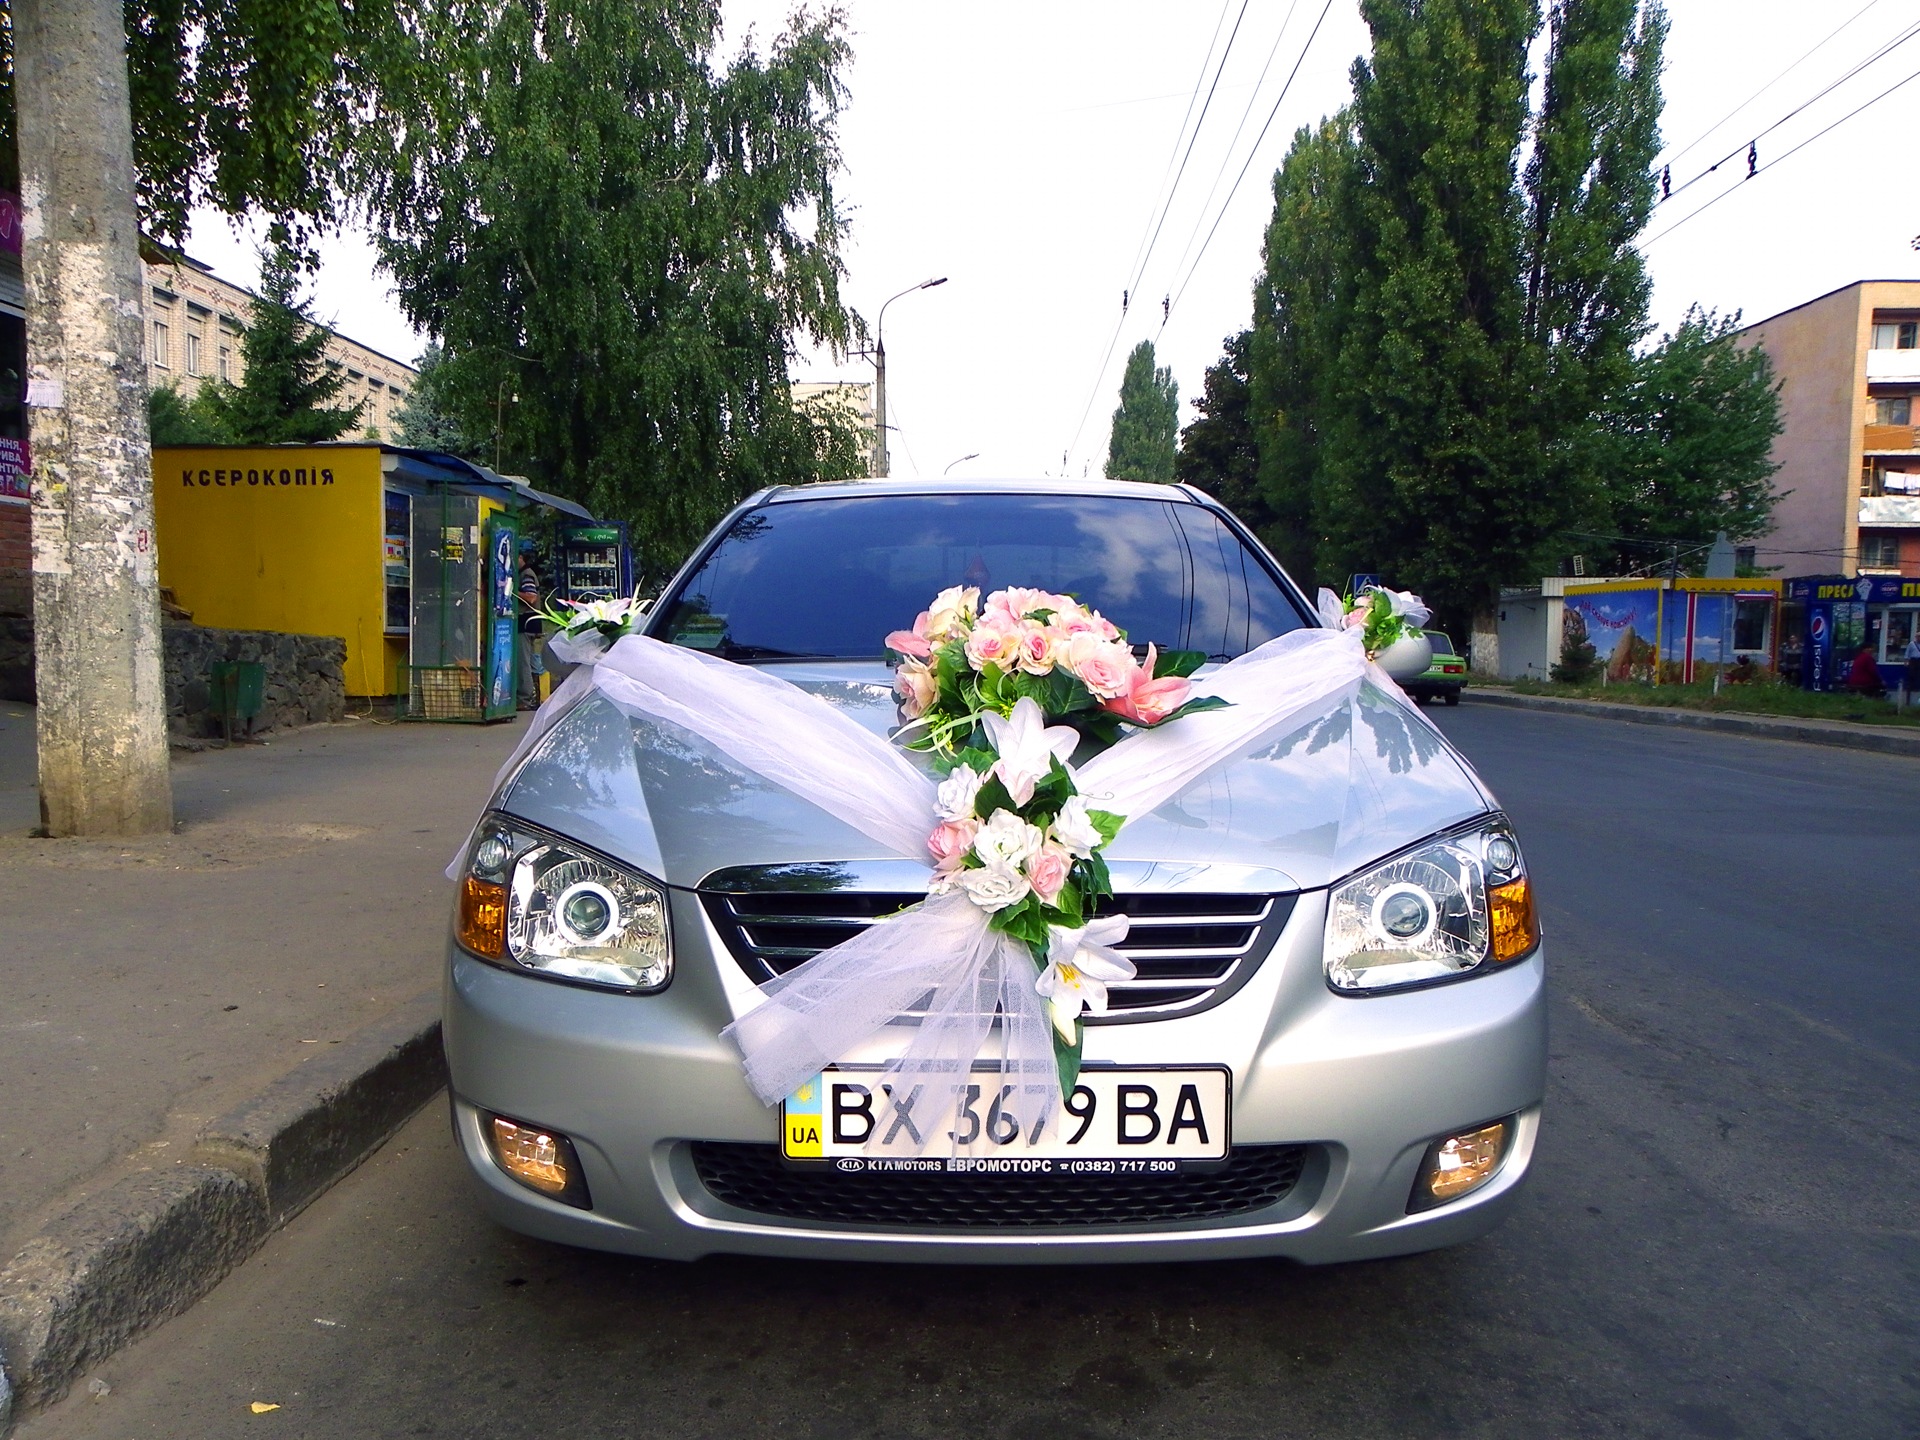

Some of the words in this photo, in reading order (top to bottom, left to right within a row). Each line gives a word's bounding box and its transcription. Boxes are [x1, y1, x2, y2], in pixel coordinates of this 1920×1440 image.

[0, 450, 24, 465] ИВА,
[182, 466, 335, 487] КСЕРОКОПІЯ
[1117, 1084, 1210, 1145] BA
[793, 1127, 819, 1144] UA
[840, 1160, 861, 1170] KIA
[946, 1159, 1052, 1172] ЕВРОМОТОРС
[1070, 1160, 1116, 1174] (0382)
[1120, 1160, 1146, 1171] 717
[1150, 1160, 1176, 1171] 500
